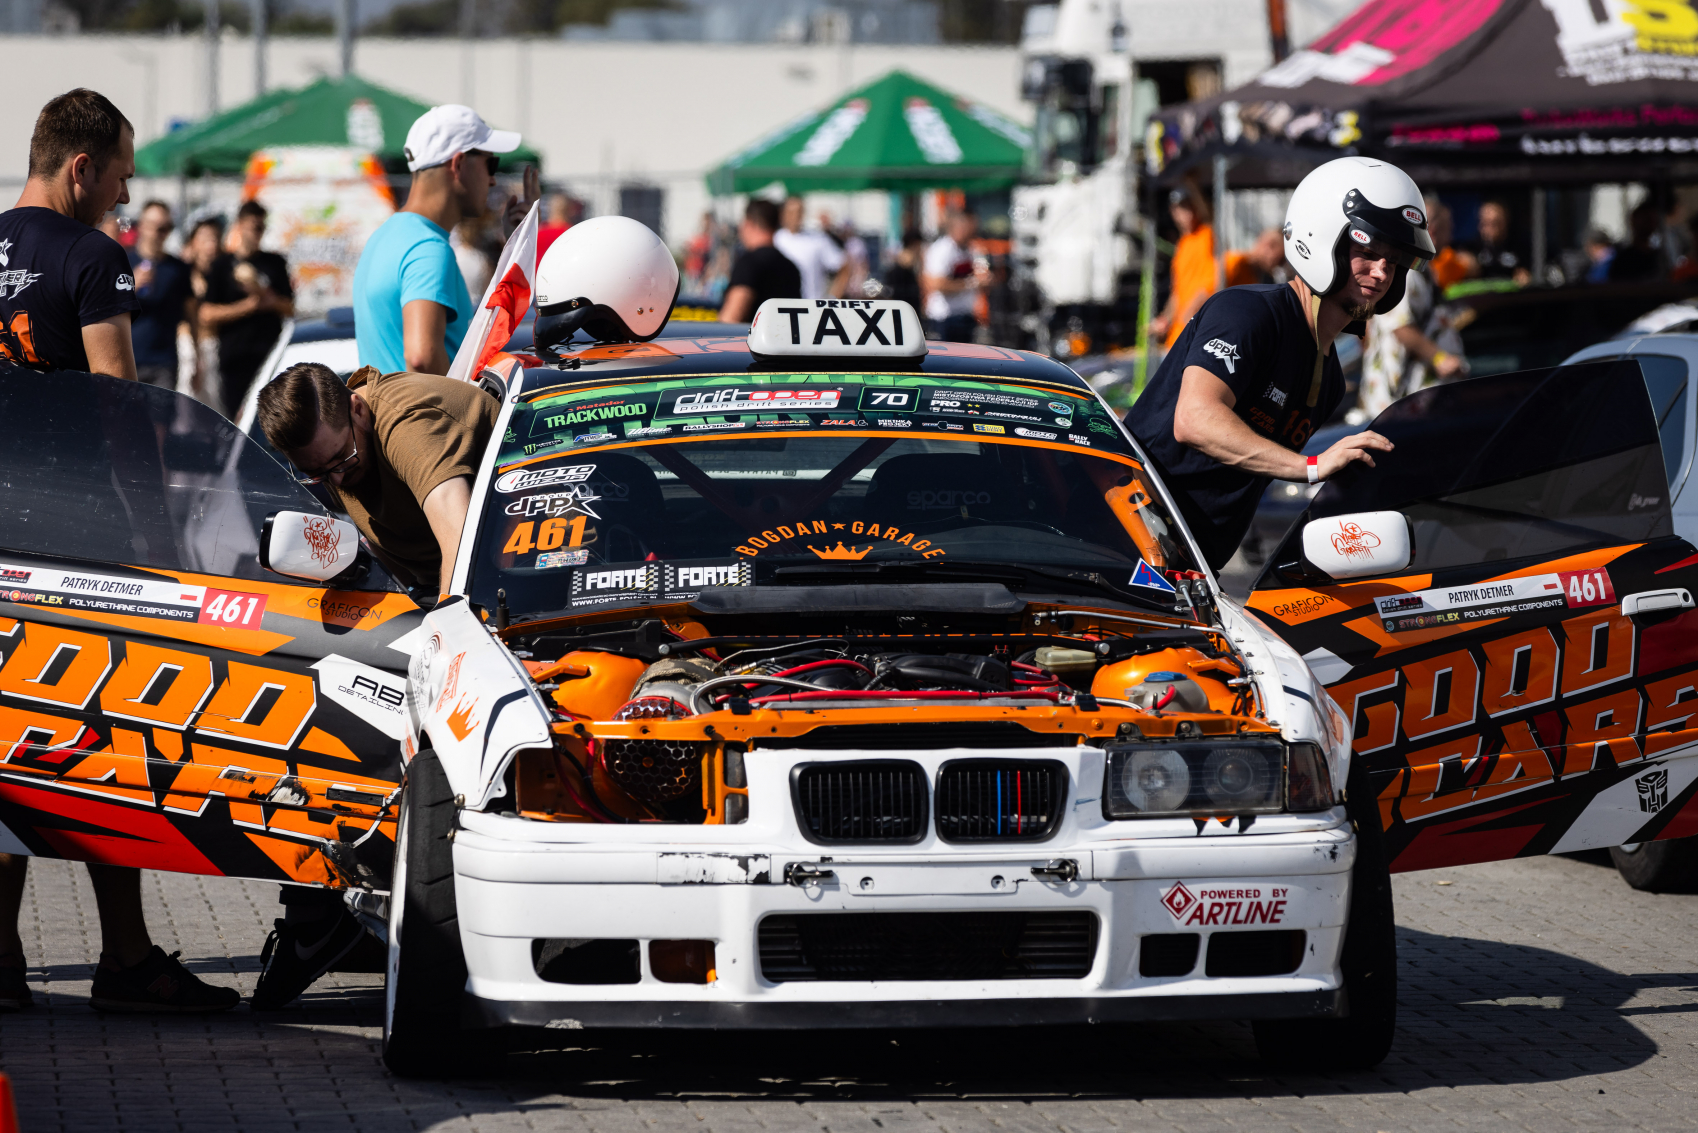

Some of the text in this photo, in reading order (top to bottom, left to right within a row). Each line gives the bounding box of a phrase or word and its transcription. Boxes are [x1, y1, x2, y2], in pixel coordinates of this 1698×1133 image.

[1406, 210, 1422, 222] BELL
[1353, 231, 1367, 242] BELL
[815, 300, 874, 309] DRIFT
[777, 307, 904, 346] TAXI
[576, 400, 626, 411] Matador
[679, 403, 729, 412] polish
[736, 400, 772, 408] drift
[870, 392, 909, 406] 70
[930, 400, 961, 408] PRO
[543, 402, 647, 429] TRACKWOOD
[519, 464, 592, 480] MOTO
[531, 492, 571, 501] GROUP
[502, 515, 588, 555] 461
[734, 520, 946, 559] BOGDAN GARAGE
[60, 576, 144, 596] PATRYK DETMER
[1448, 584, 1515, 605] PATRYK DETMER
[1569, 572, 1607, 604] 461
[69, 597, 194, 619] POLYURETHANE COMPONENTS
[205, 593, 259, 626] 461
[306, 597, 383, 621] GRAFICON
[324, 608, 360, 621] STUDIO
[1273, 593, 1335, 617] GRAFICON
[1293, 603, 1321, 617] STUDIO
[1463, 598, 1563, 619] POLYURETHANE COMPONENTS
[1398, 611, 1460, 629] STRONGFLEX
[0, 617, 318, 752] OOD
[351, 674, 405, 707] AB
[1325, 606, 1638, 757] GOOD
[337, 684, 405, 716] DETAILIN
[1200, 888, 1289, 900] POWERED BY
[1184, 900, 1288, 927] ARTLINE
